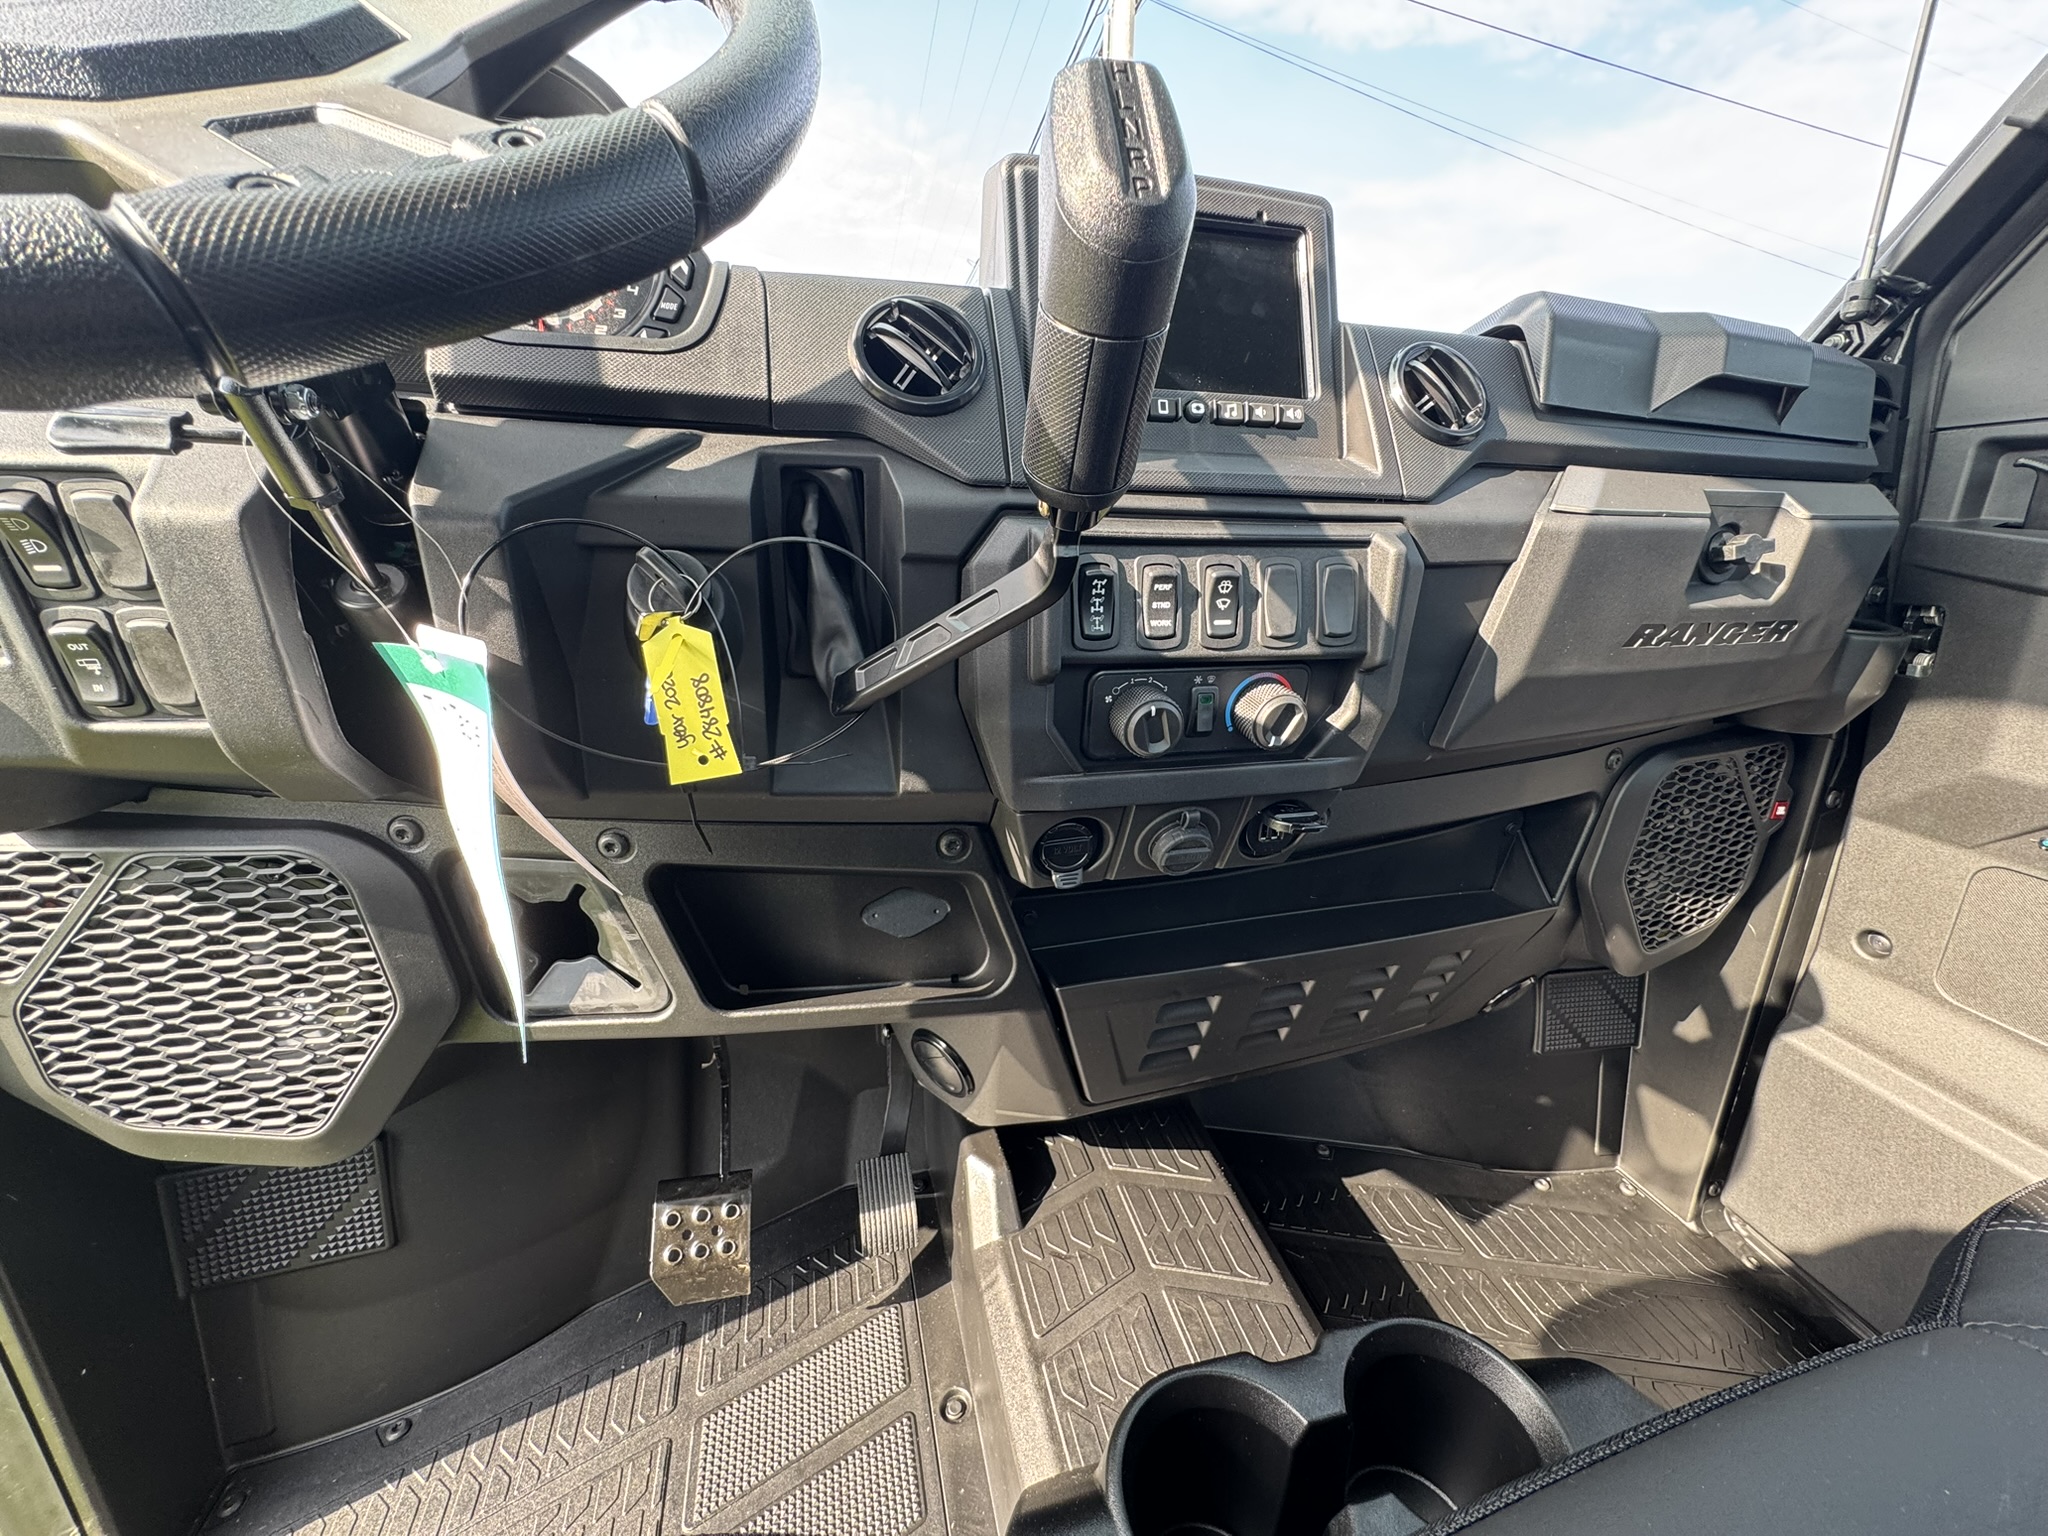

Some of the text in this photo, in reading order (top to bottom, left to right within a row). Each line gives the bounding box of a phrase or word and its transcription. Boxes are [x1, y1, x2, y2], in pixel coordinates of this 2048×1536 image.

[626, 285, 639, 295] 4
[660, 302, 678, 311] MODE
[613, 308, 626, 319] 3
[594, 324, 608, 335] 2
[1153, 583, 1173, 591] PERF
[1151, 601, 1171, 609] STND
[1149, 619, 1172, 627] WORK
[1621, 620, 1799, 649] RANGER
[66, 643, 89, 651] OUT
[92, 684, 104, 692] IN
